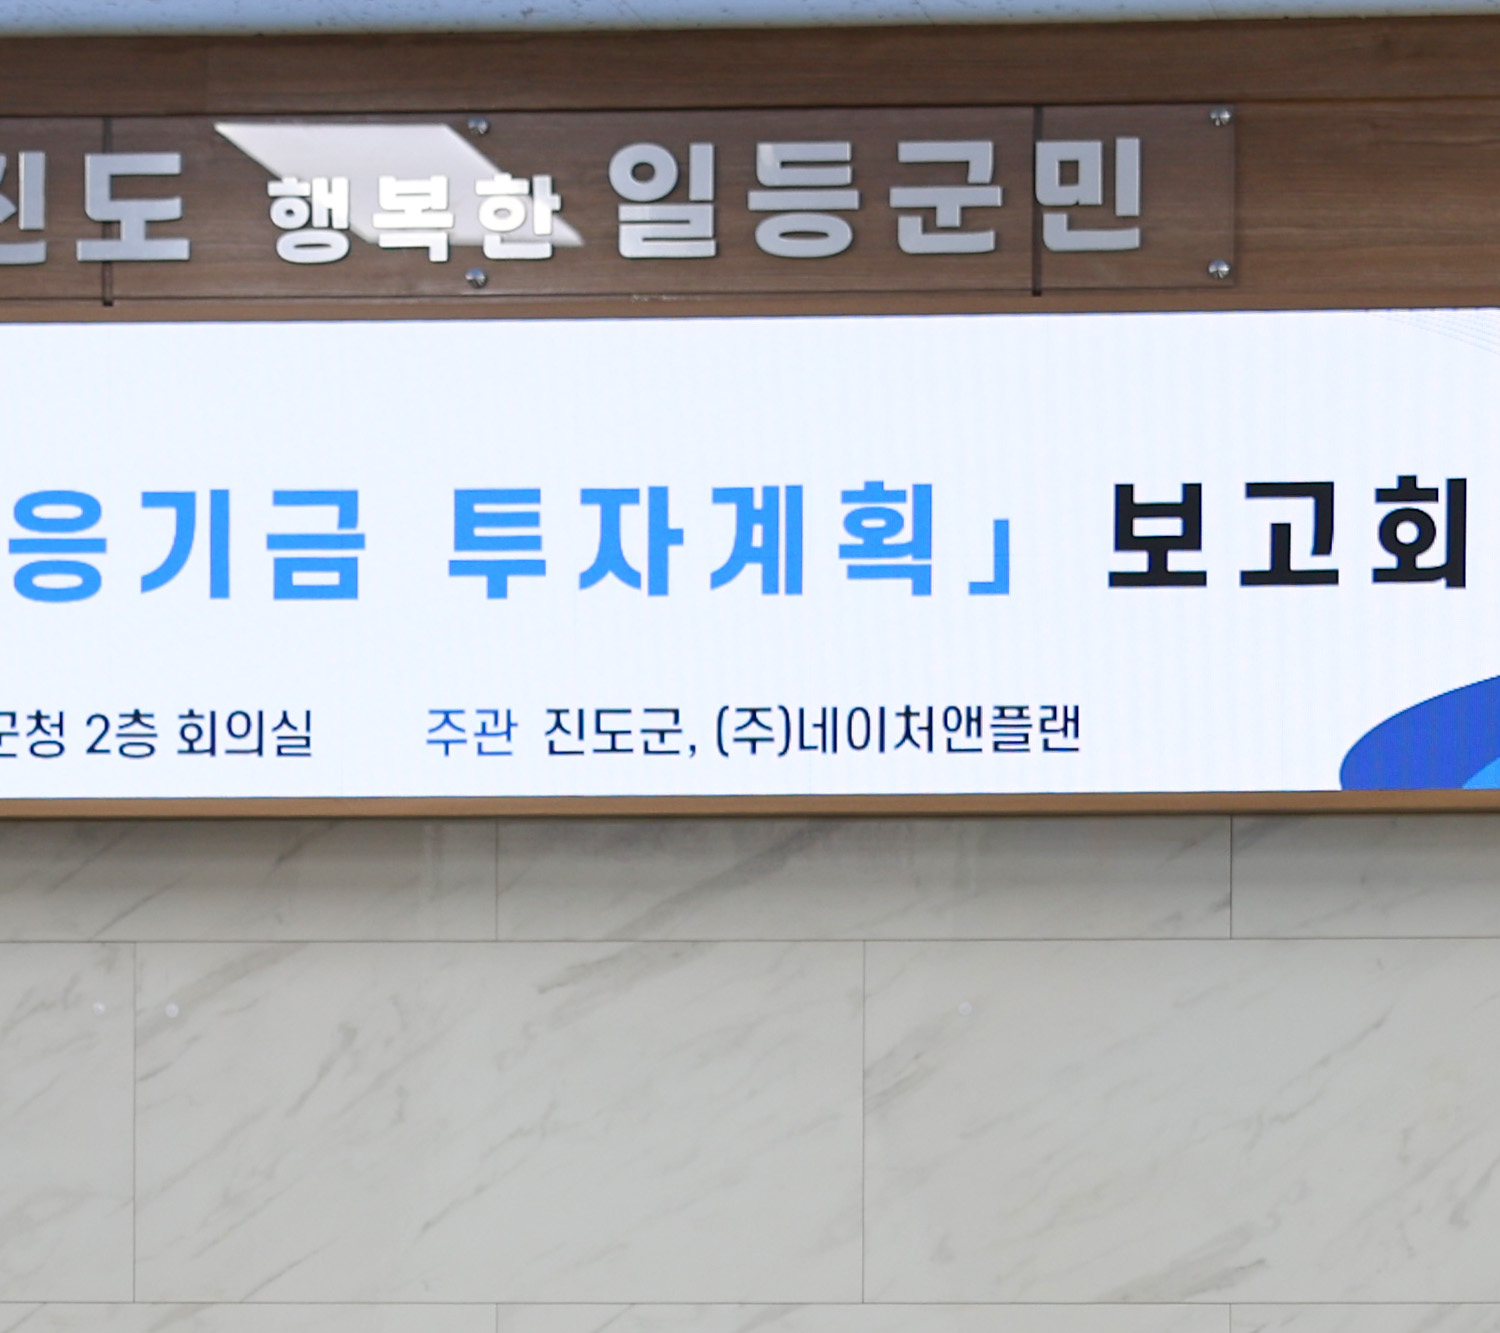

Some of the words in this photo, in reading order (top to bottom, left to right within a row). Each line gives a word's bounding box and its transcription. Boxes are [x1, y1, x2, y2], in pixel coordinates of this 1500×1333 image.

[267, 174, 562, 263] 행복한
[608, 137, 1141, 259] 일등군민
[448, 480, 1010, 600] 투자계획」
[1107, 474, 1468, 590] 보고회
[85, 708, 158, 759] 2층
[177, 708, 312, 758] 회의실
[426, 708, 518, 757] 주관
[544, 707, 697, 758] 진도군,
[716, 704, 1080, 758] (주)네이처앤플랜
